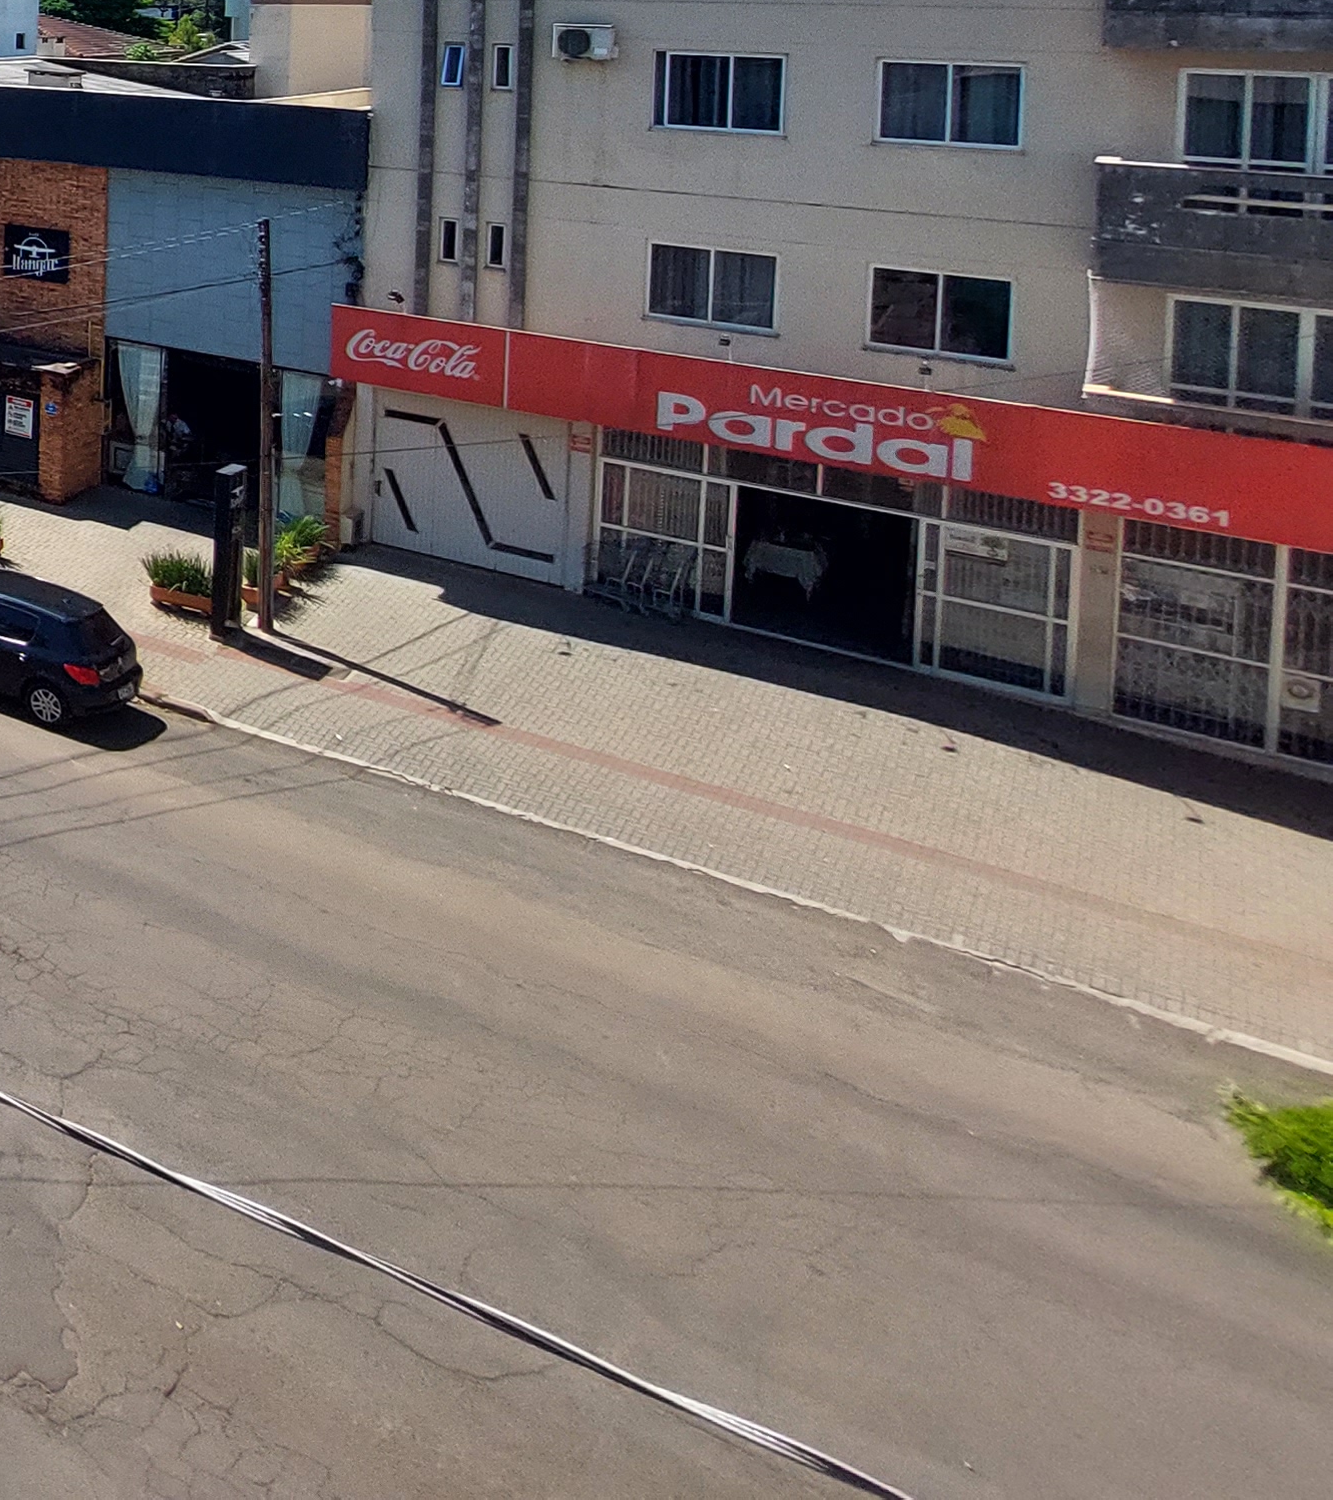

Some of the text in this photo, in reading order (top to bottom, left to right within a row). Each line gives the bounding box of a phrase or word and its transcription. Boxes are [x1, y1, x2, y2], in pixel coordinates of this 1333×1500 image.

[345, 328, 482, 379] Coca-Cola
[749, 383, 937, 431] Mercado
[656, 390, 973, 482] Pardal
[1047, 481, 1230, 527] 3322-0361
